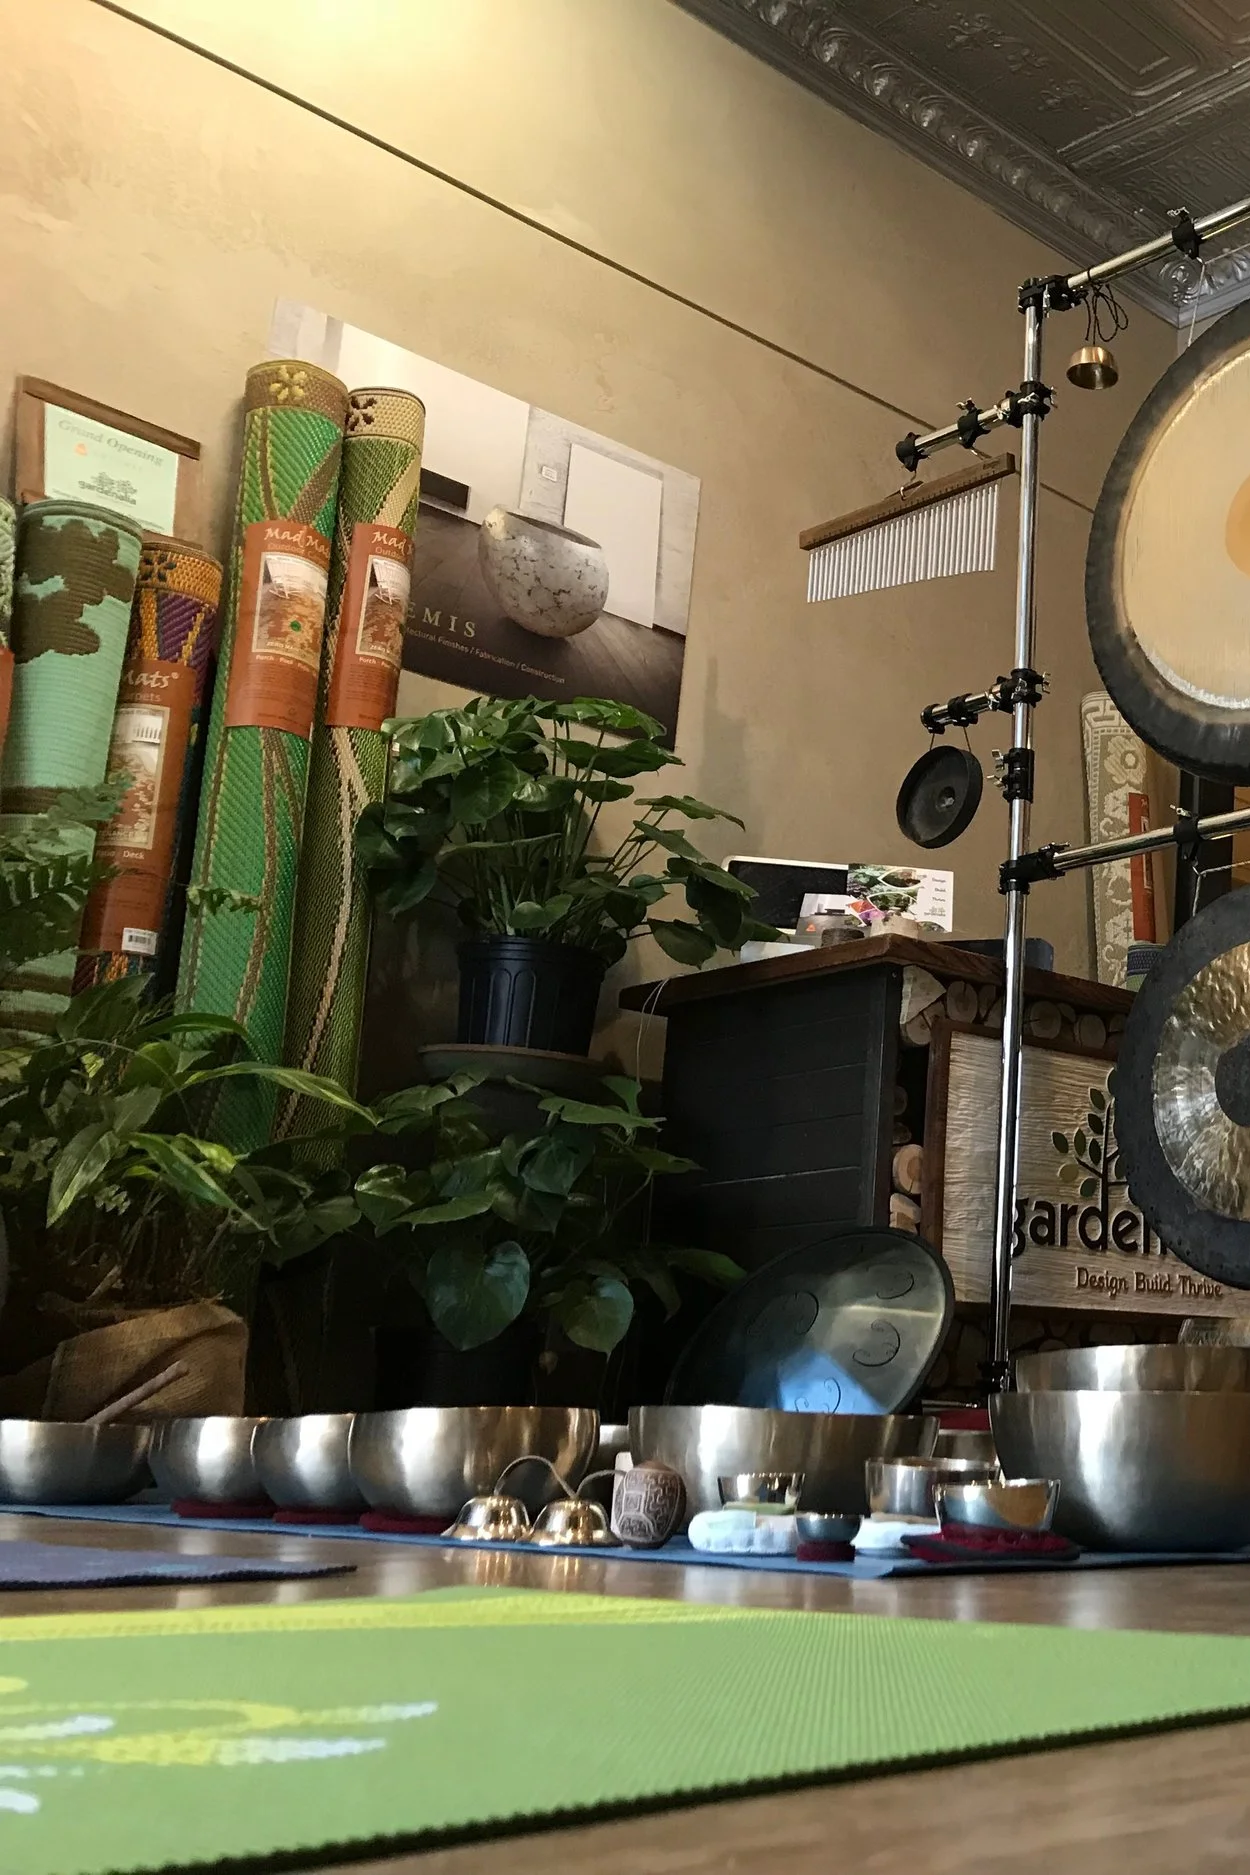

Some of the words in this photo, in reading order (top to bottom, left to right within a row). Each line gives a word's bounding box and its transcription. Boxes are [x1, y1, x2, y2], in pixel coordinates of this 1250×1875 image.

[58, 419, 104, 443] Grand
[106, 437, 164, 467] Opening
[264, 527, 305, 548] Mad
[371, 531, 407, 556] Mad
[359, 656, 377, 664] Porch
[437, 635, 470, 654] Finishes
[475, 648, 516, 667] Fabrication
[520, 663, 566, 685] Construction
[123, 850, 145, 860] Deck
[1075, 1266, 1129, 1299] Design
[1133, 1270, 1173, 1294] Build
[1176, 1273, 1224, 1297] Thrive
